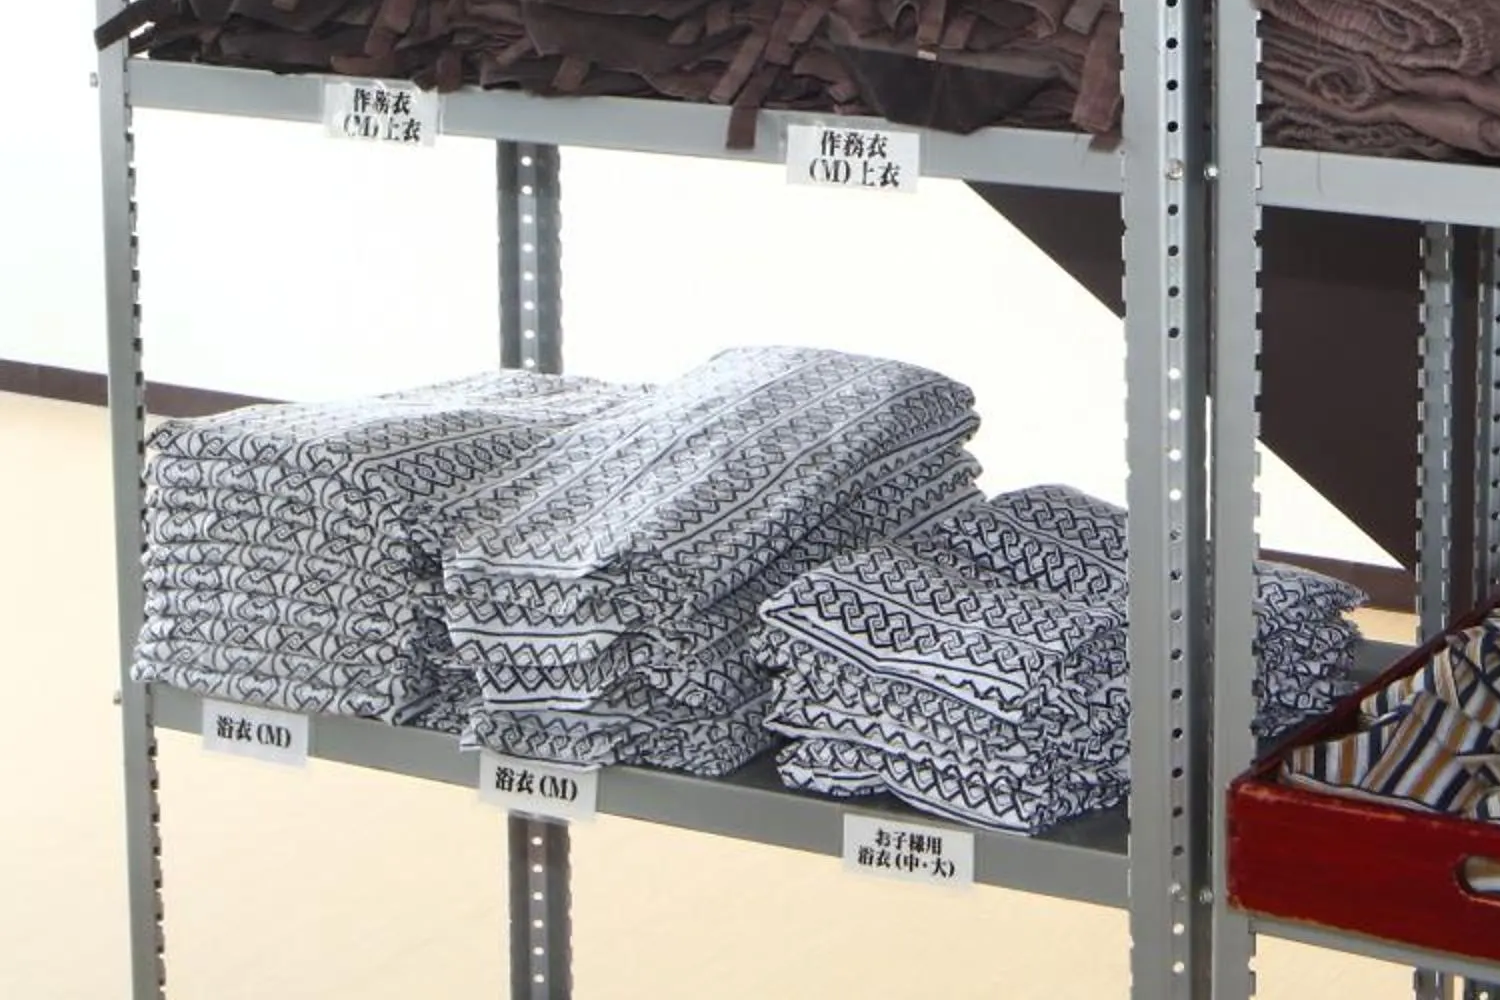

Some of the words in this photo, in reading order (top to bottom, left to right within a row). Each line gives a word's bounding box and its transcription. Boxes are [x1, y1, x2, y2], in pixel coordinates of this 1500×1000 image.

[353, 88, 411, 115] 作務衣
[821, 130, 887, 158] 作務衣
[809, 158, 900, 187] (M)上衣
[216, 714, 292, 748] 浴衣(M)
[495, 766, 578, 802] 浴衣(M)
[875, 828, 942, 856] お子様用
